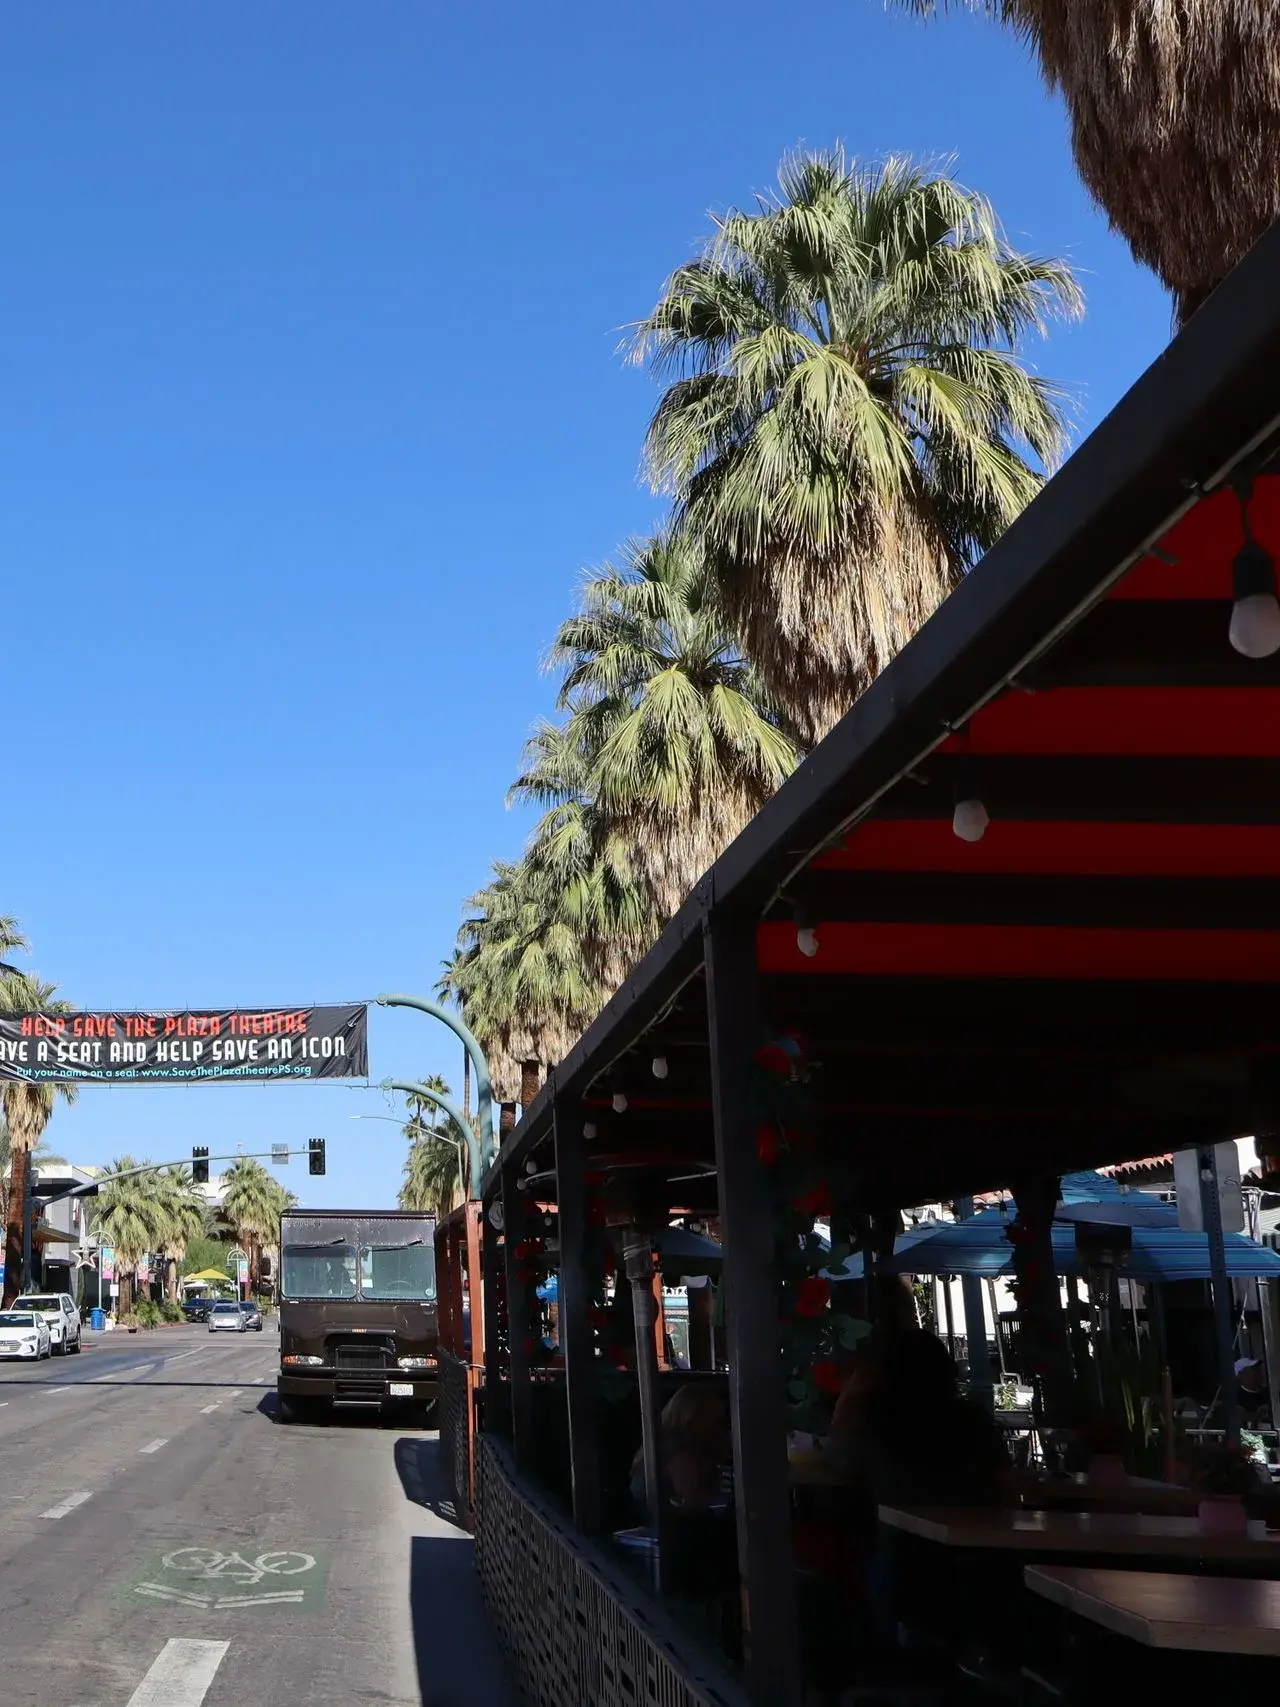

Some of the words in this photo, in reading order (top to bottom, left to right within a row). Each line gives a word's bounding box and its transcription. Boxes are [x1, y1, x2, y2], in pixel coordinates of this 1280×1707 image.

[20, 1016, 67, 1037] HELP
[73, 1017, 116, 1037] SAVE
[124, 1017, 157, 1037] THE
[163, 1016, 220, 1037] PLAZA
[228, 1014, 308, 1035] THEATRE
[37, 1042, 48, 1062] A
[57, 1041, 102, 1063] SEAT
[110, 1041, 147, 1063] AND
[155, 1040, 203, 1062] HELP
[212, 1039, 258, 1061] SAVE
[267, 1038, 292, 1060] AN
[302, 1036, 346, 1058] ICON
[16, 1067, 32, 1076] Put
[34, 1068, 57, 1078] your
[60, 1069, 88, 1077] name
[91, 1069, 103, 1077] on
[106, 1069, 112, 1077] a
[114, 1067, 139, 1077] seat:
[142, 1064, 312, 1078] www.SaveThePlazaTheatrePS.org
